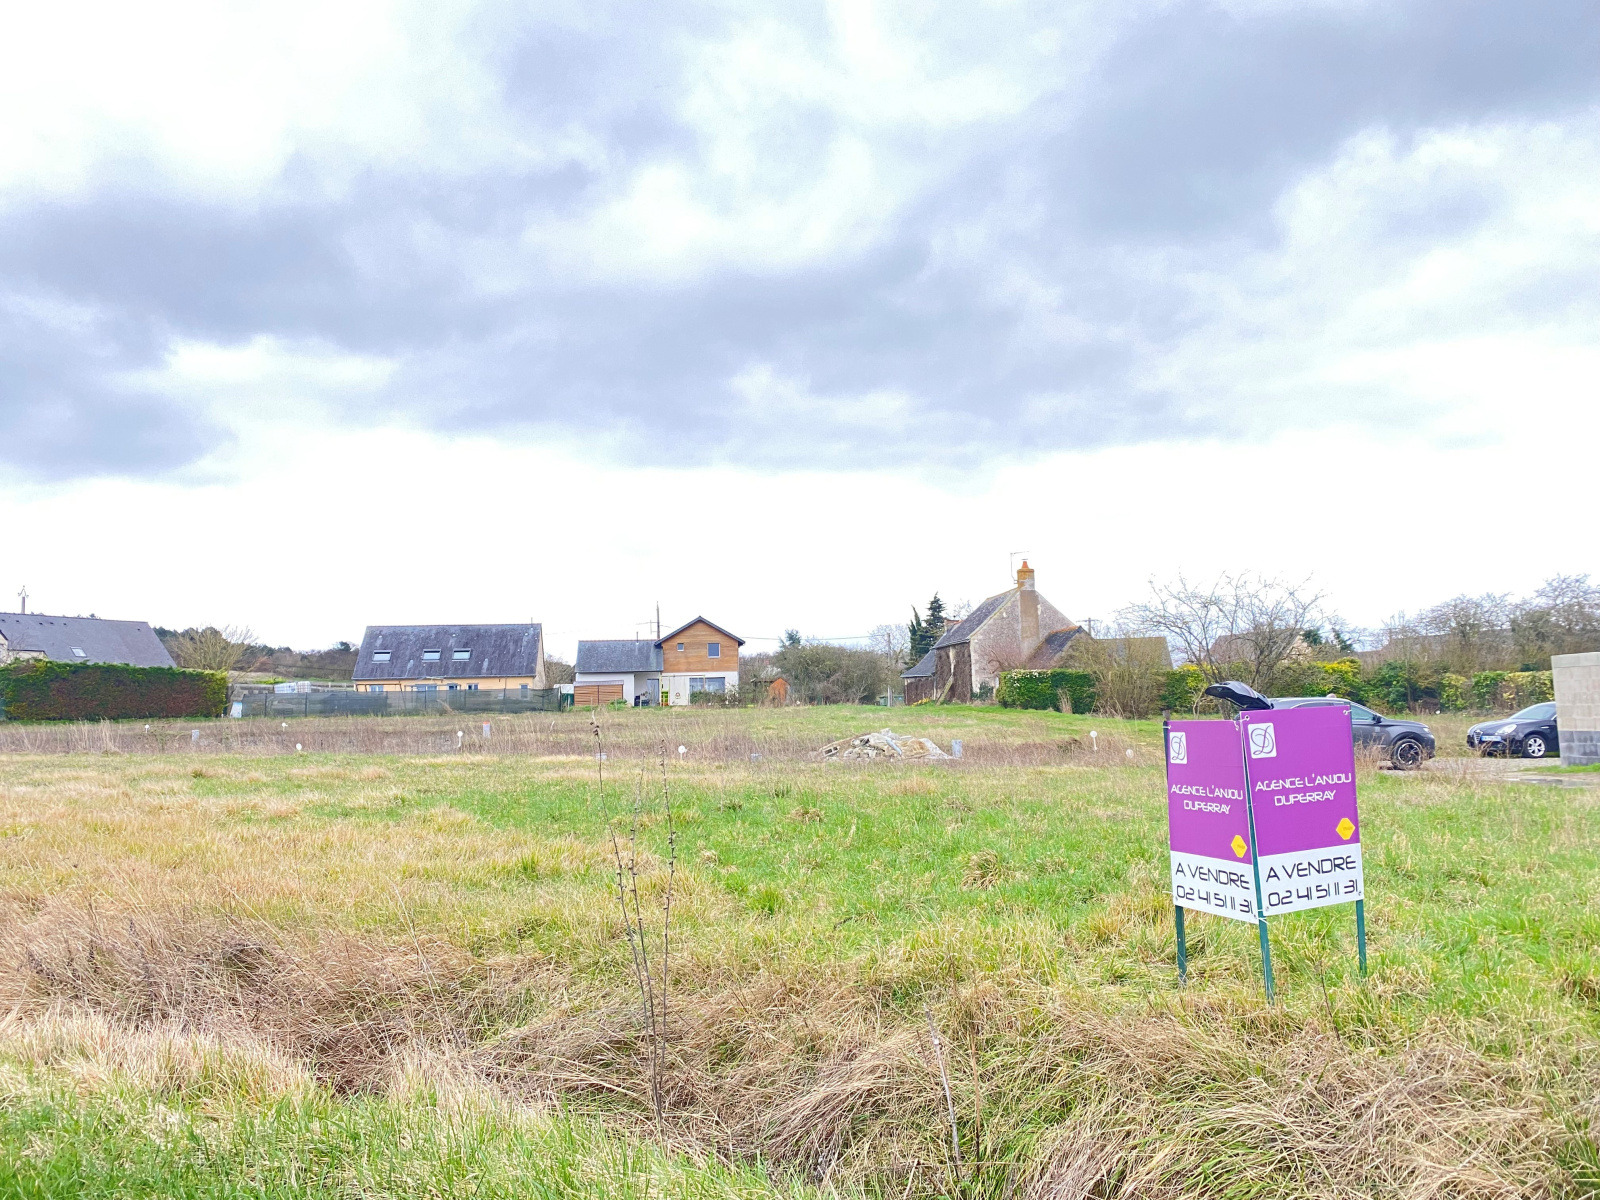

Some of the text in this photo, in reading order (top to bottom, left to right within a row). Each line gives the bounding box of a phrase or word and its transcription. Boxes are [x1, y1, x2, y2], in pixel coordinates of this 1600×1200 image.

[1171, 784, 1243, 800] AGENCE L'ANJOU
[1255, 773, 1352, 792] AGENCE L'ANJOU
[1183, 800, 1231, 814] DUPERRAY
[1274, 790, 1336, 806] DUPERRAY
[1175, 862, 1250, 890] A VENDRE
[1265, 855, 1357, 883] A VENDRE
[1176, 885, 1254, 914] 02 41 51 11 31
[1267, 879, 1358, 907] 02 41 51 11 31
